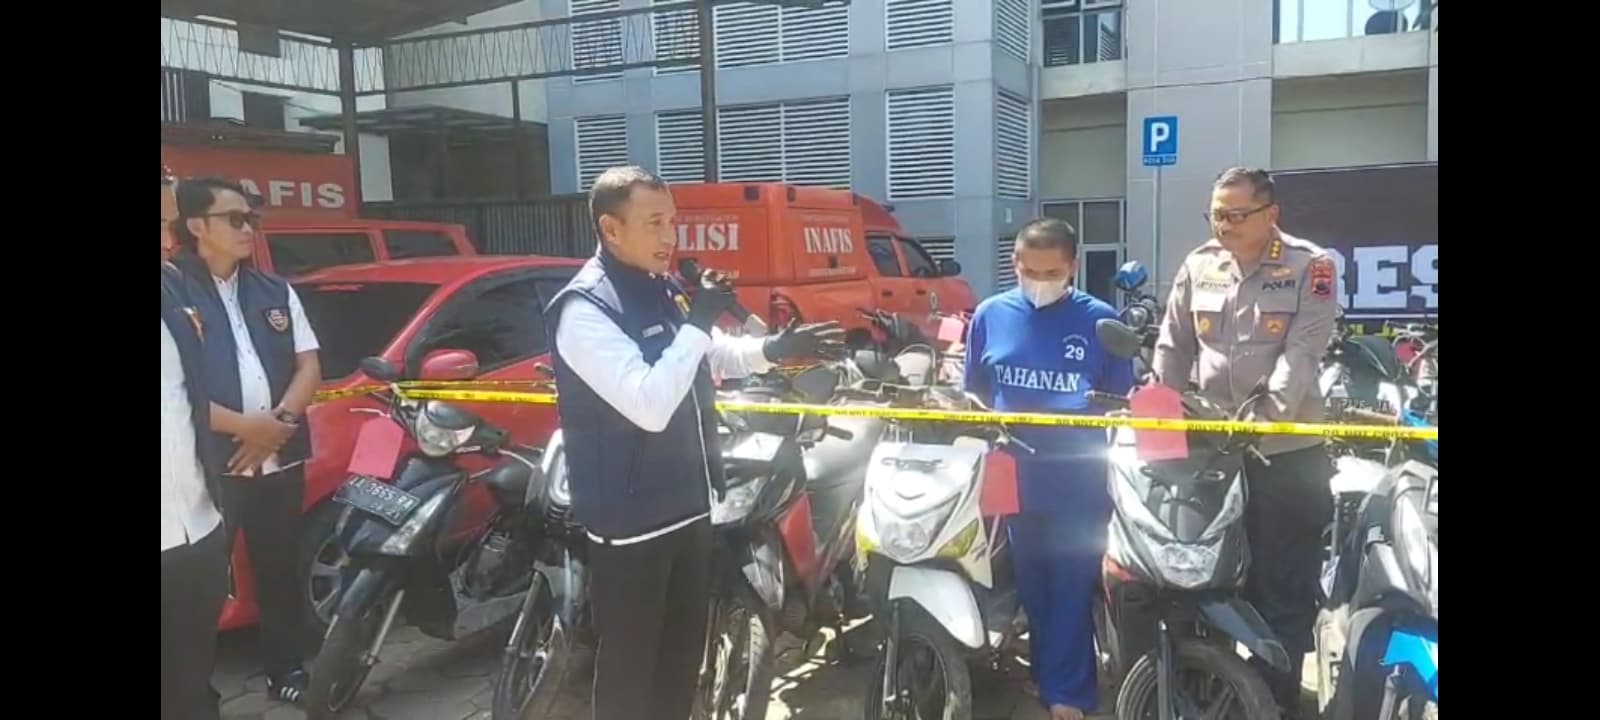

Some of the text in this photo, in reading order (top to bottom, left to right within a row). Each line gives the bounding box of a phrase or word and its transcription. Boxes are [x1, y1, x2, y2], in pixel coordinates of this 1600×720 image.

[1151, 122, 1169, 152] P
[239, 178, 345, 209] AFIS
[677, 223, 739, 251] LISI
[804, 226, 853, 254] INAFIS
[1262, 279, 1296, 291] POLRI
[1064, 344, 1085, 361] 29
[994, 364, 1081, 393] TAHANAN
[366, 482, 397, 500] 3665
